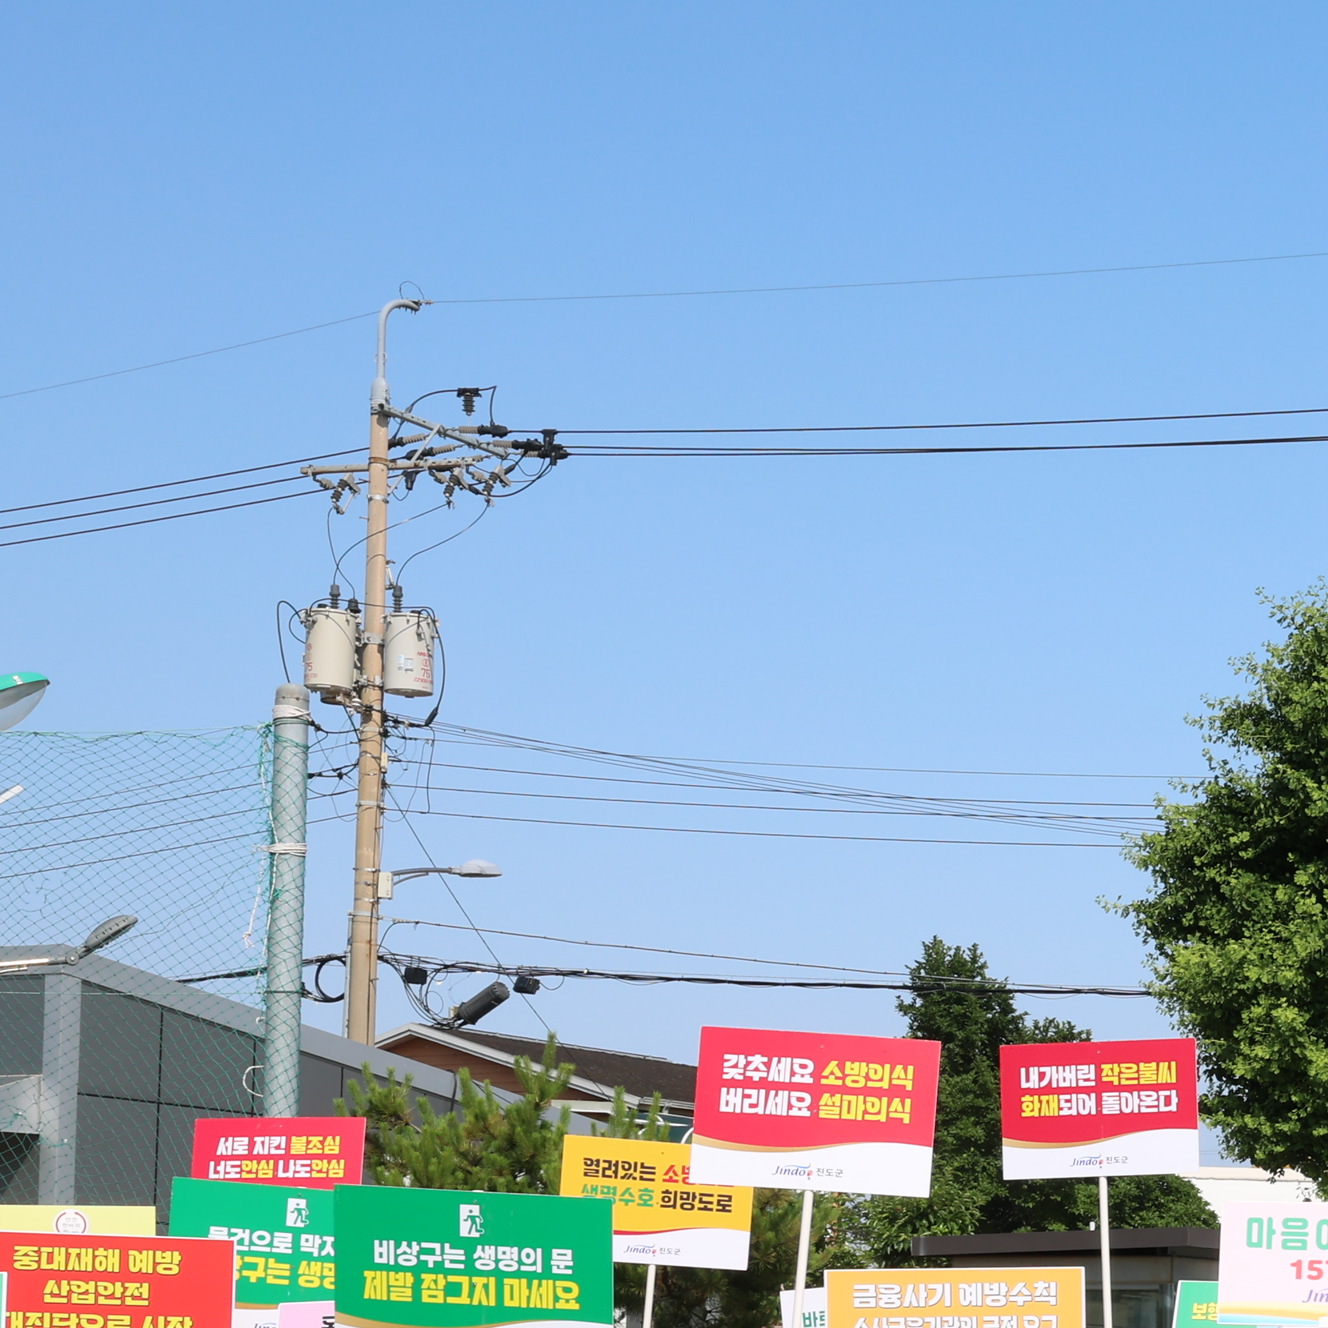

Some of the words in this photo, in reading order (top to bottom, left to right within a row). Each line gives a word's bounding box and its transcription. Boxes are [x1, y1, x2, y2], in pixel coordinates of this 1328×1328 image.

[721, 1053, 814, 1085] 갖추세요
[820, 1059, 915, 1091] 소방의식
[1020, 1063, 1097, 1089] 내가버린
[1101, 1060, 1177, 1086] 작은불씨
[719, 1087, 812, 1118] 버리세요
[818, 1093, 912, 1125] 설마의식
[1020, 1093, 1097, 1118] 화재되어
[1101, 1090, 1178, 1115] 돌아온다
[216, 1136, 249, 1156] 서로
[253, 1135, 286, 1156] 지킨
[290, 1135, 341, 1155] 불조심
[208, 1160, 274, 1179] 너도안심
[277, 1159, 345, 1179] 나도안심
[583, 1157, 657, 1183] 열려있는
[815, 1167, 844, 1179] 진도군
[1105, 1155, 1128, 1165] 진도군
[12, 1245, 121, 1274] 중대재해
[127, 1249, 182, 1276] 예방
[373, 1239, 467, 1270] 비상구는
[473, 1245, 543, 1274] 생명의
[550, 1248, 574, 1275] 문
[43, 1279, 151, 1307] 산업안전
[363, 1270, 415, 1303] 제발
[420, 1272, 497, 1307] 잠그지
[503, 1277, 581, 1310] 마세요
[852, 1282, 952, 1309] 금융사기
[958, 1280, 1058, 1307] 예방수칙
